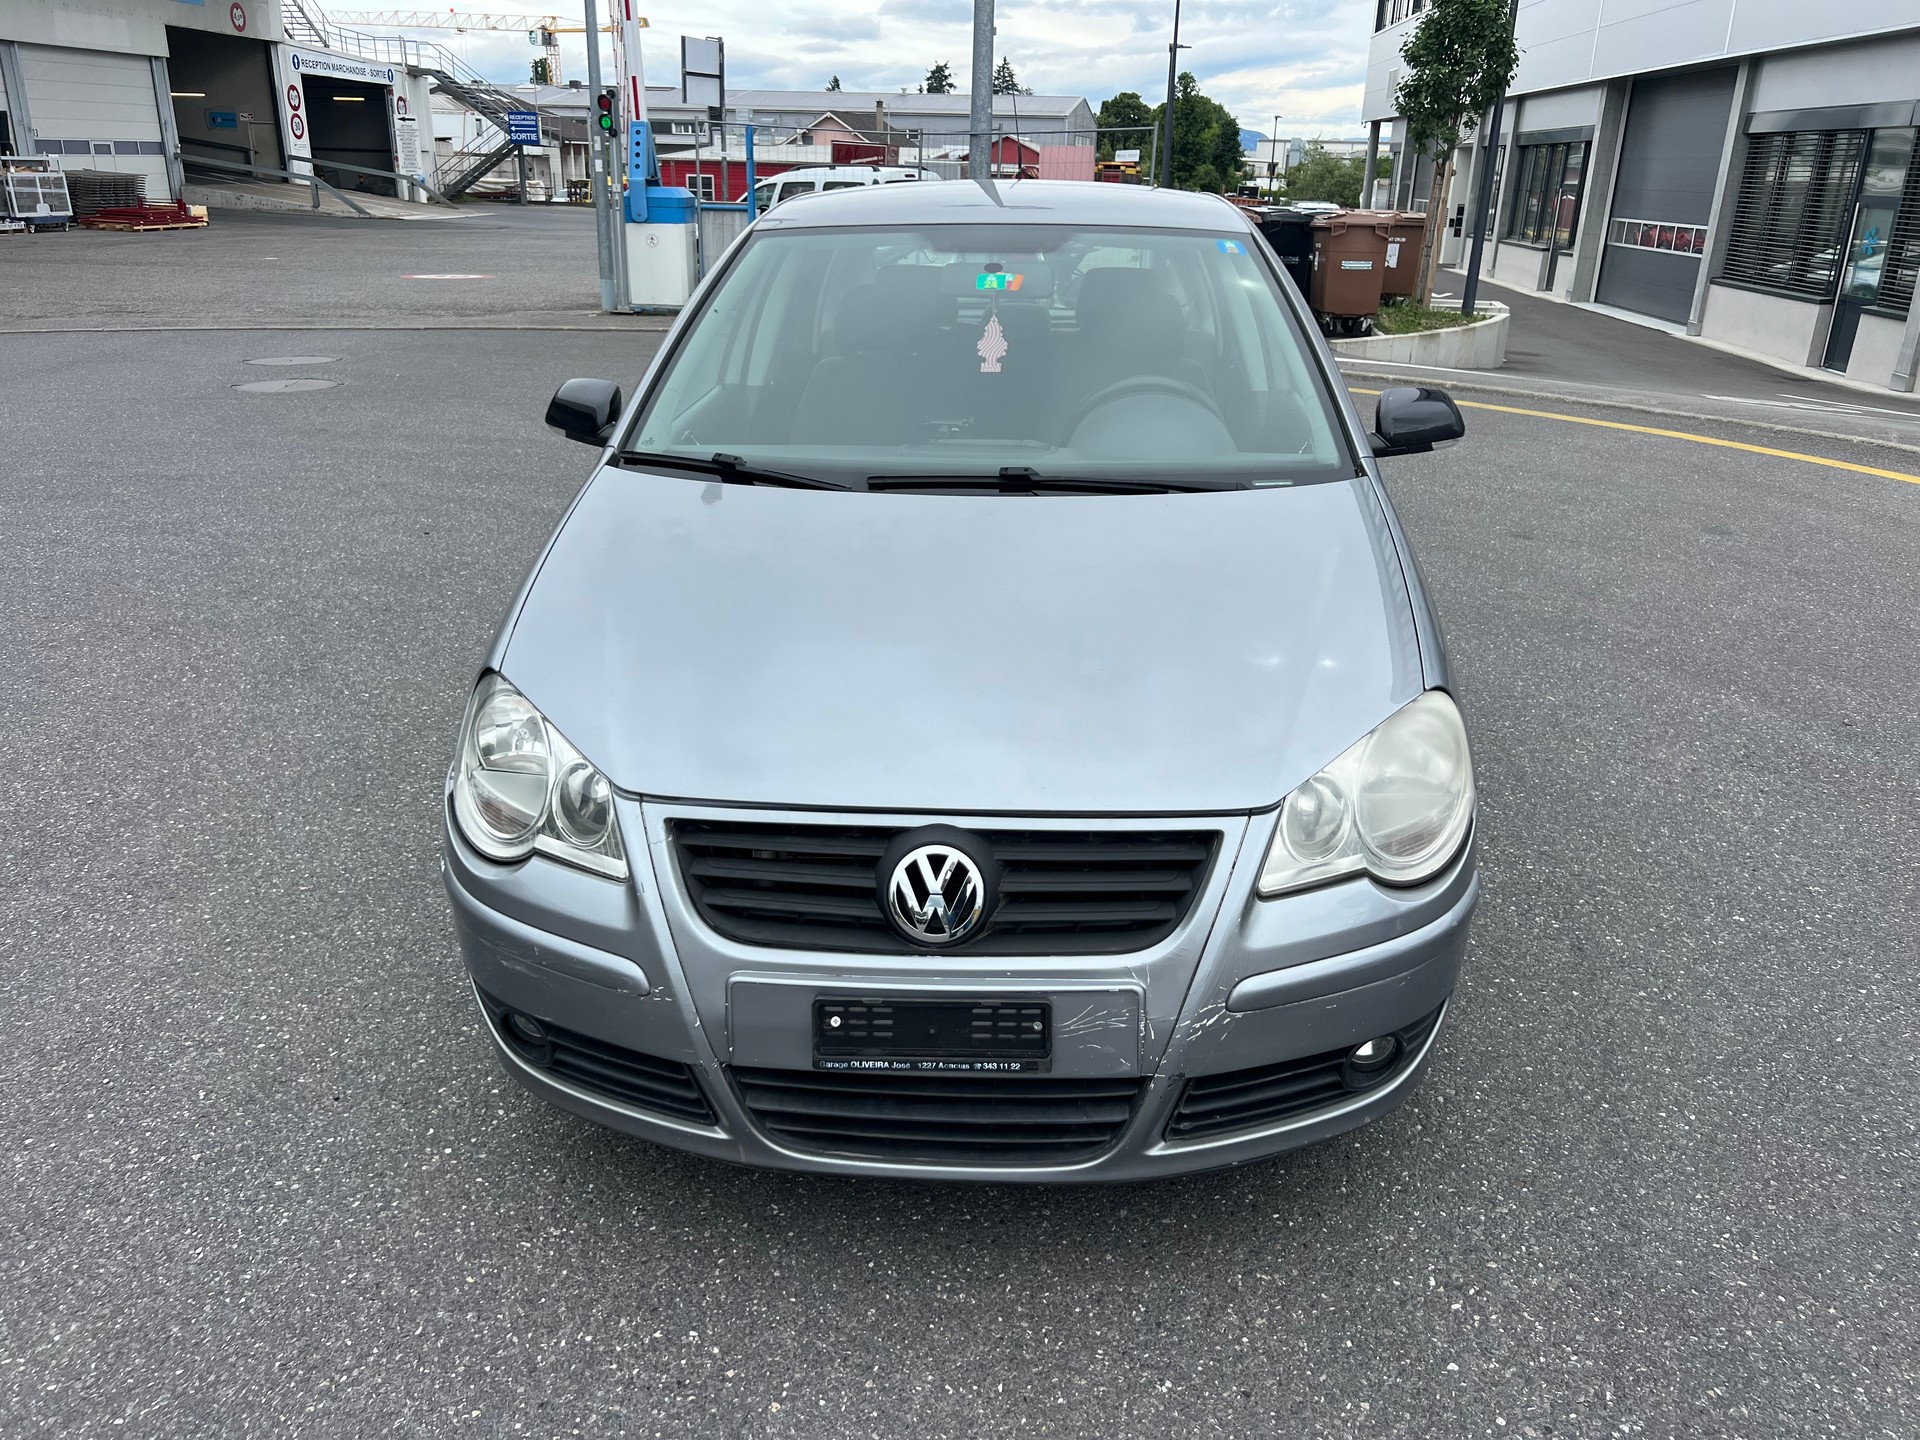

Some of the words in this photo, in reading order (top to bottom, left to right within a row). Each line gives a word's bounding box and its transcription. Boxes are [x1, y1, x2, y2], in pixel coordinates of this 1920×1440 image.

[301, 58, 331, 71] RECEPTION
[331, 62, 366, 76] MARCHANDISE
[370, 68, 386, 79] SORTIE
[511, 132, 538, 140] SORTIE
[889, 844, 984, 943] VW
[819, 1060, 849, 1070] Garage
[850, 1060, 889, 1069] OLIVEIRA
[891, 1060, 911, 1069] José
[917, 1061, 937, 1069] 1227
[983, 1062, 998, 1070] 343
[1000, 1062, 1008, 1070] 11
[1010, 1062, 1021, 1070] 22
